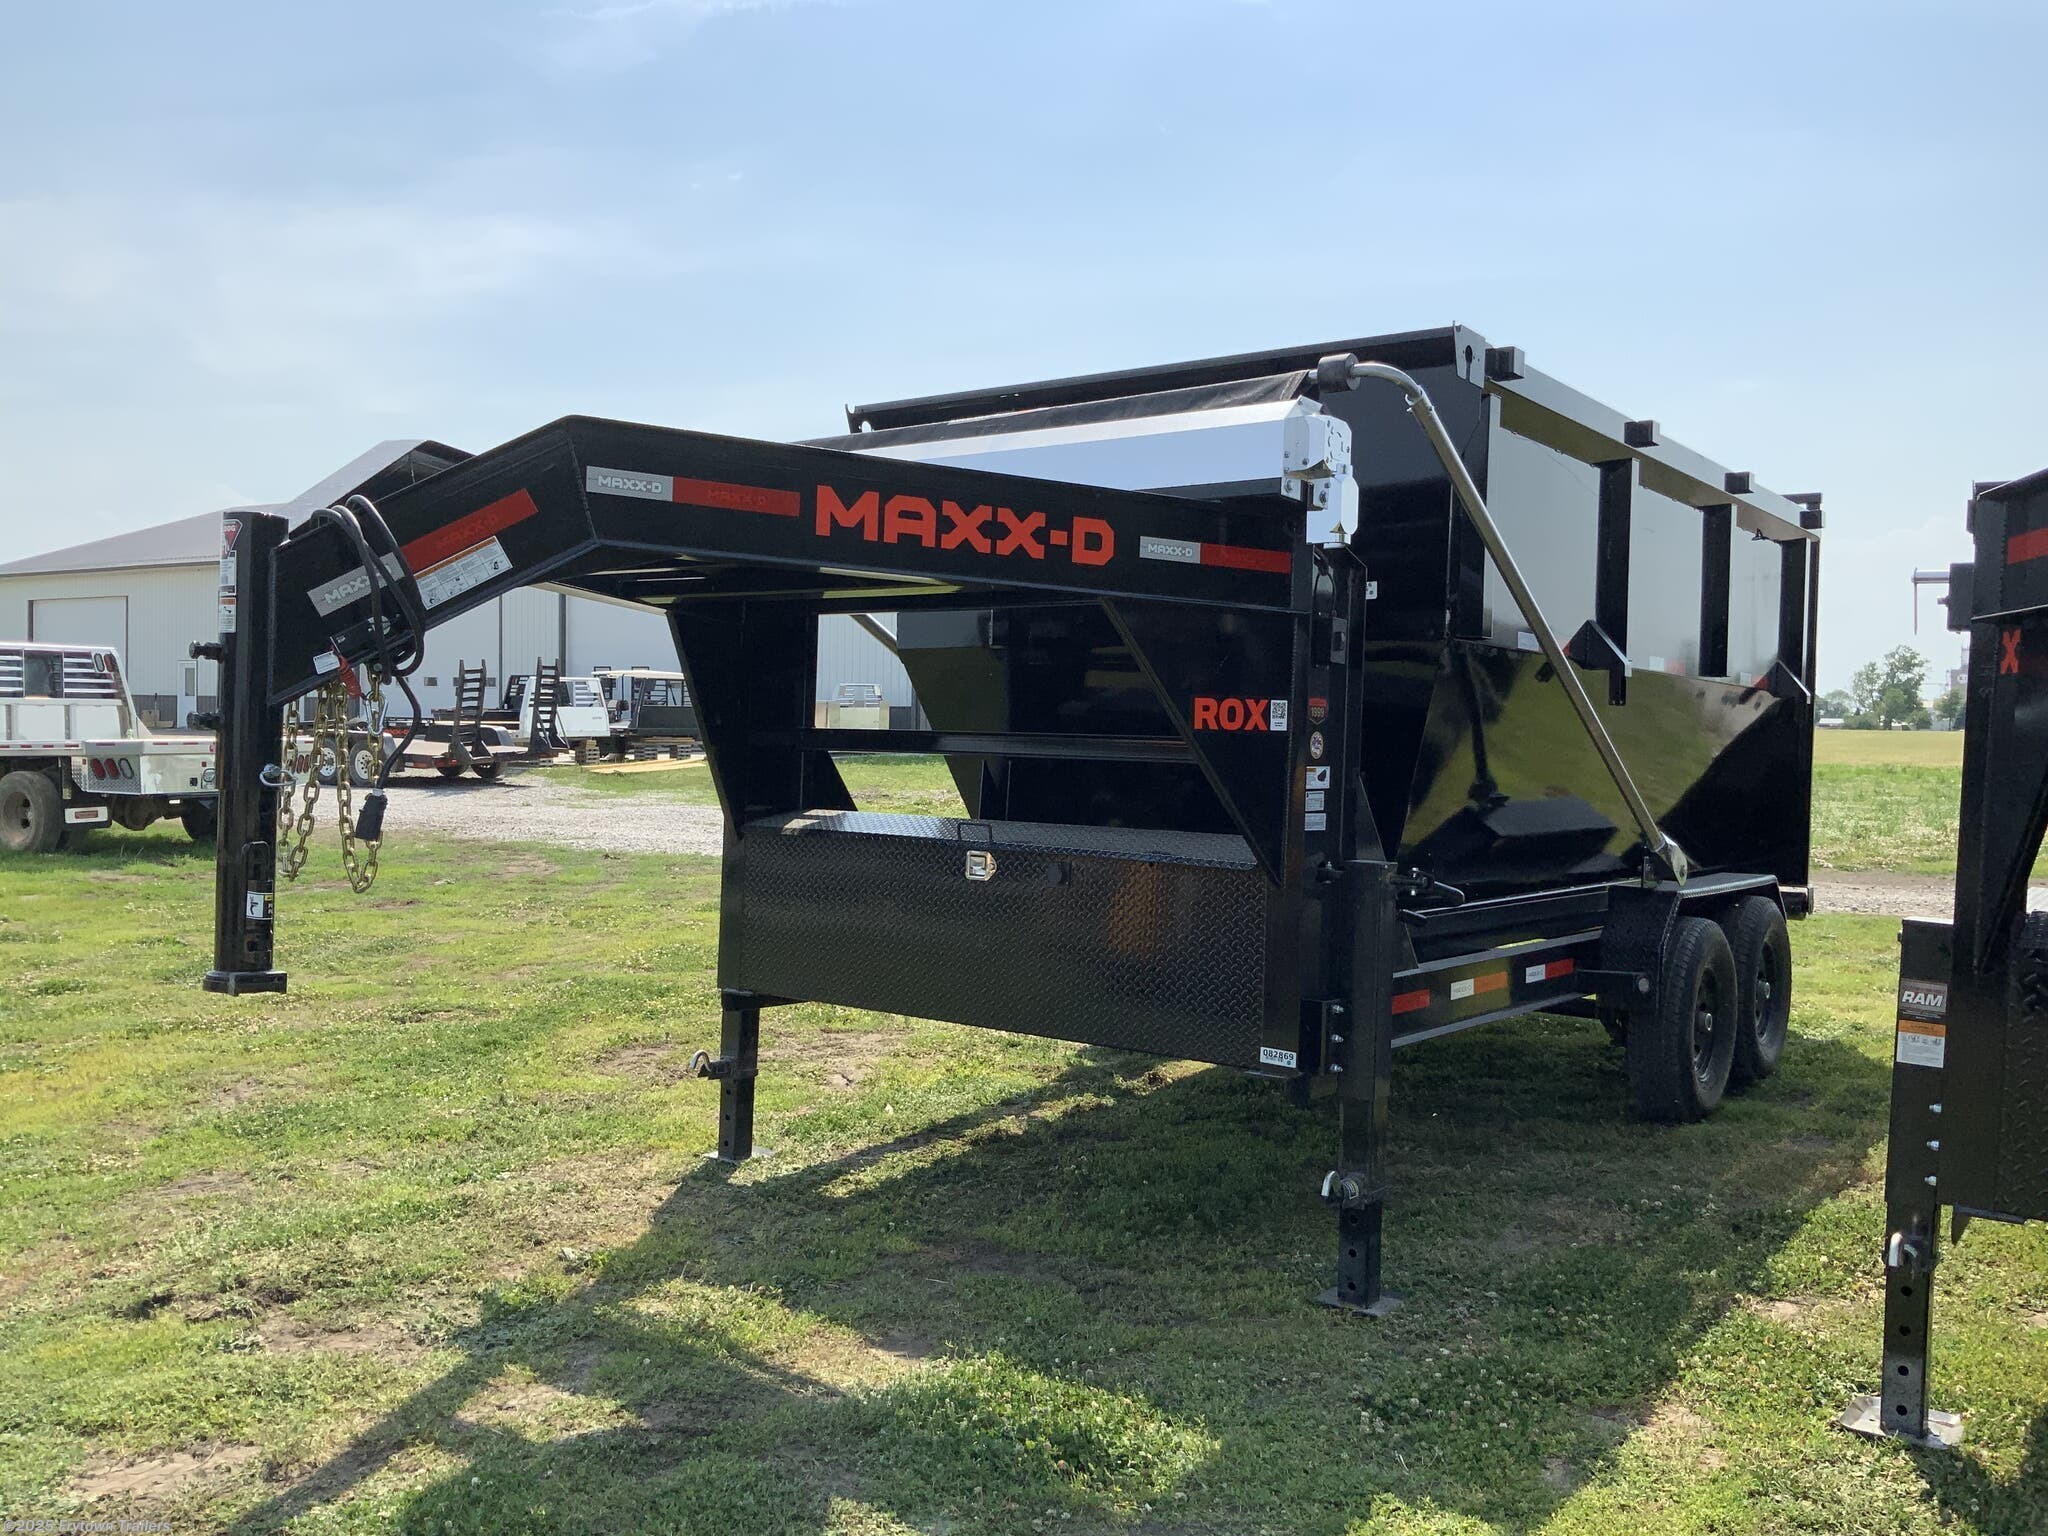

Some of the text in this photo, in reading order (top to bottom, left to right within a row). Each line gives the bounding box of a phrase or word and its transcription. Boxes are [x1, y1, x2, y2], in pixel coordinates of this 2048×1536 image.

[598, 475, 662, 494] MAXX-D
[815, 484, 1115, 566] MAXX-D
[1148, 543, 1193, 557] MAXX-D
[1193, 697, 1269, 731] ROX
[1902, 991, 1943, 1007] RAM
[1263, 1049, 1294, 1060] 082869
